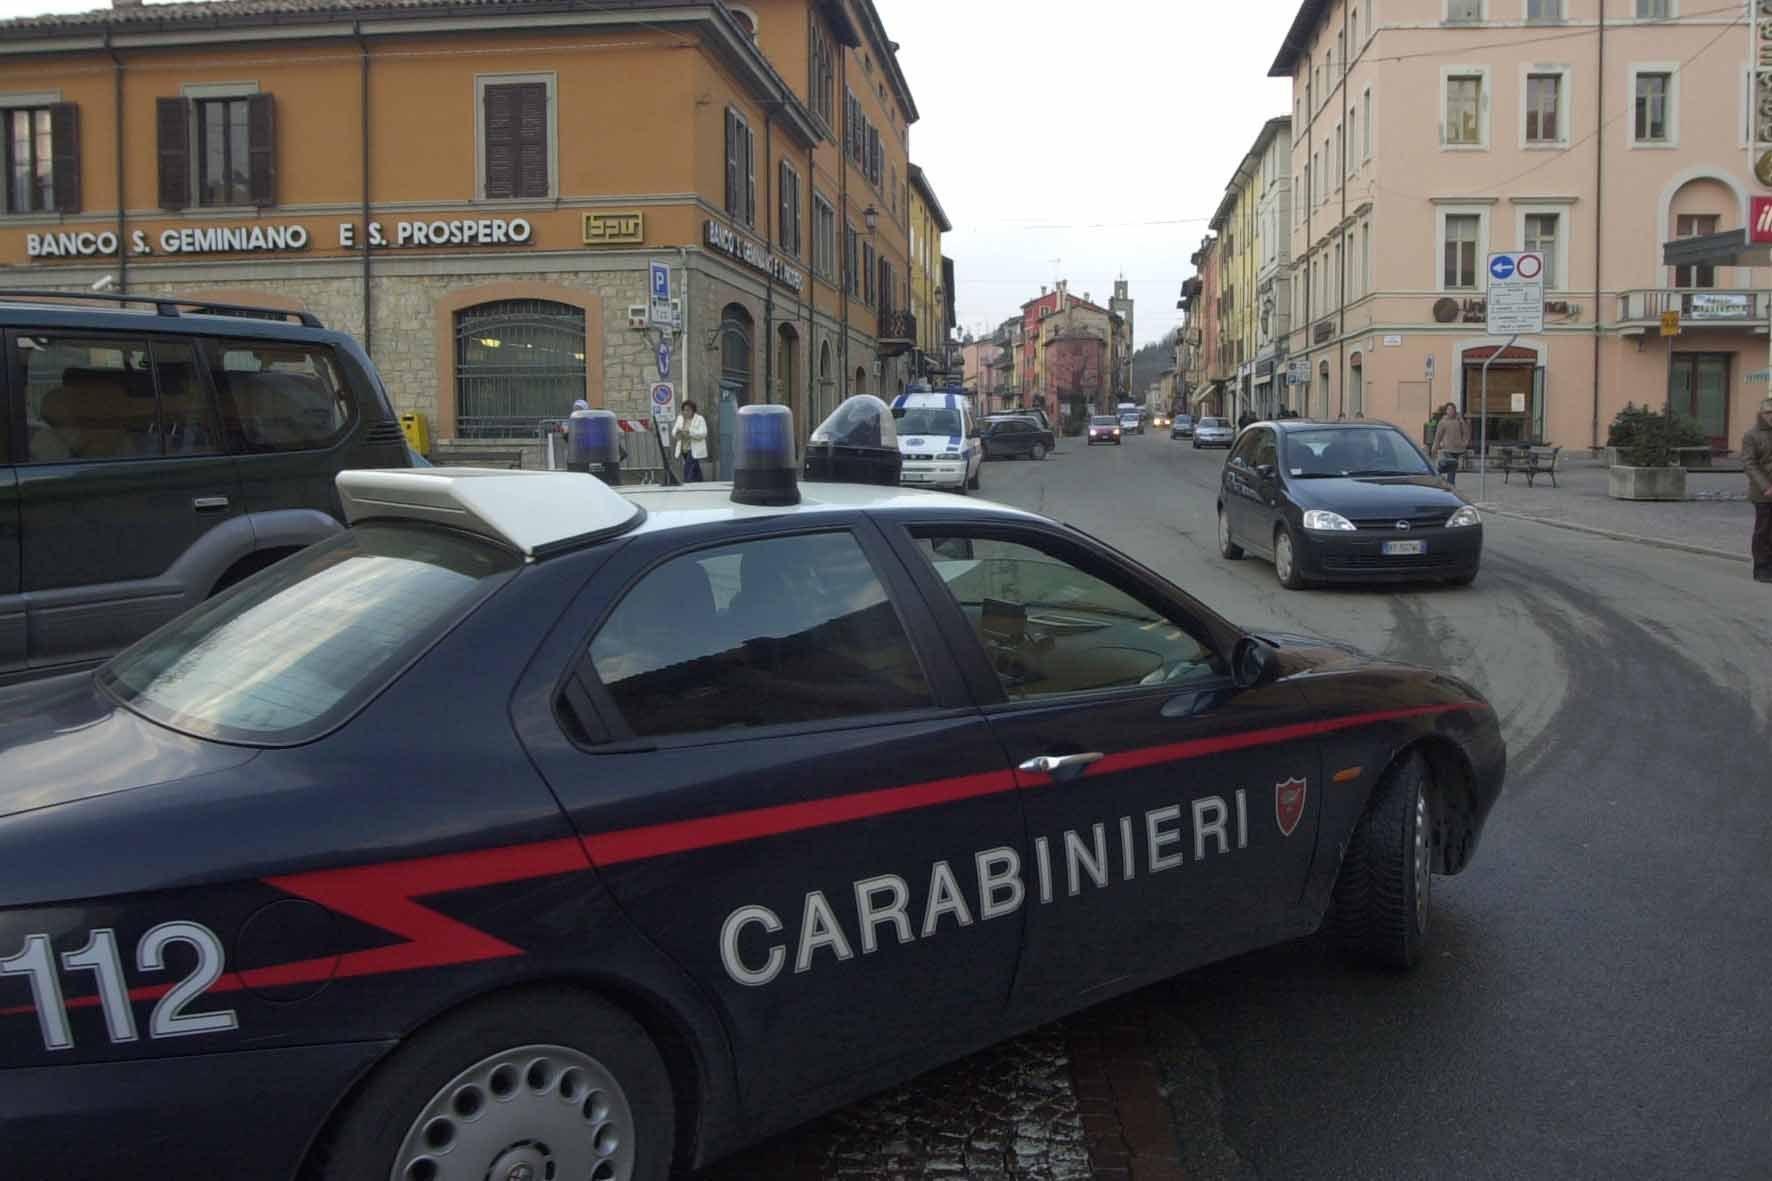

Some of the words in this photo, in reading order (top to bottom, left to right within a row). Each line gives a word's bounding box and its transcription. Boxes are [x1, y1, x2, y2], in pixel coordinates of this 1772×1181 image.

[27, 231, 117, 256] BANCO
[132, 230, 150, 253] S.
[160, 225, 307, 252] GEMINIANO
[340, 223, 352, 246] E
[368, 222, 386, 245] S.
[398, 218, 531, 245] PROSPERO
[656, 271, 665, 291] P
[719, 788, 1248, 986] CARABINIERI
[0, 920, 239, 1051] 112
